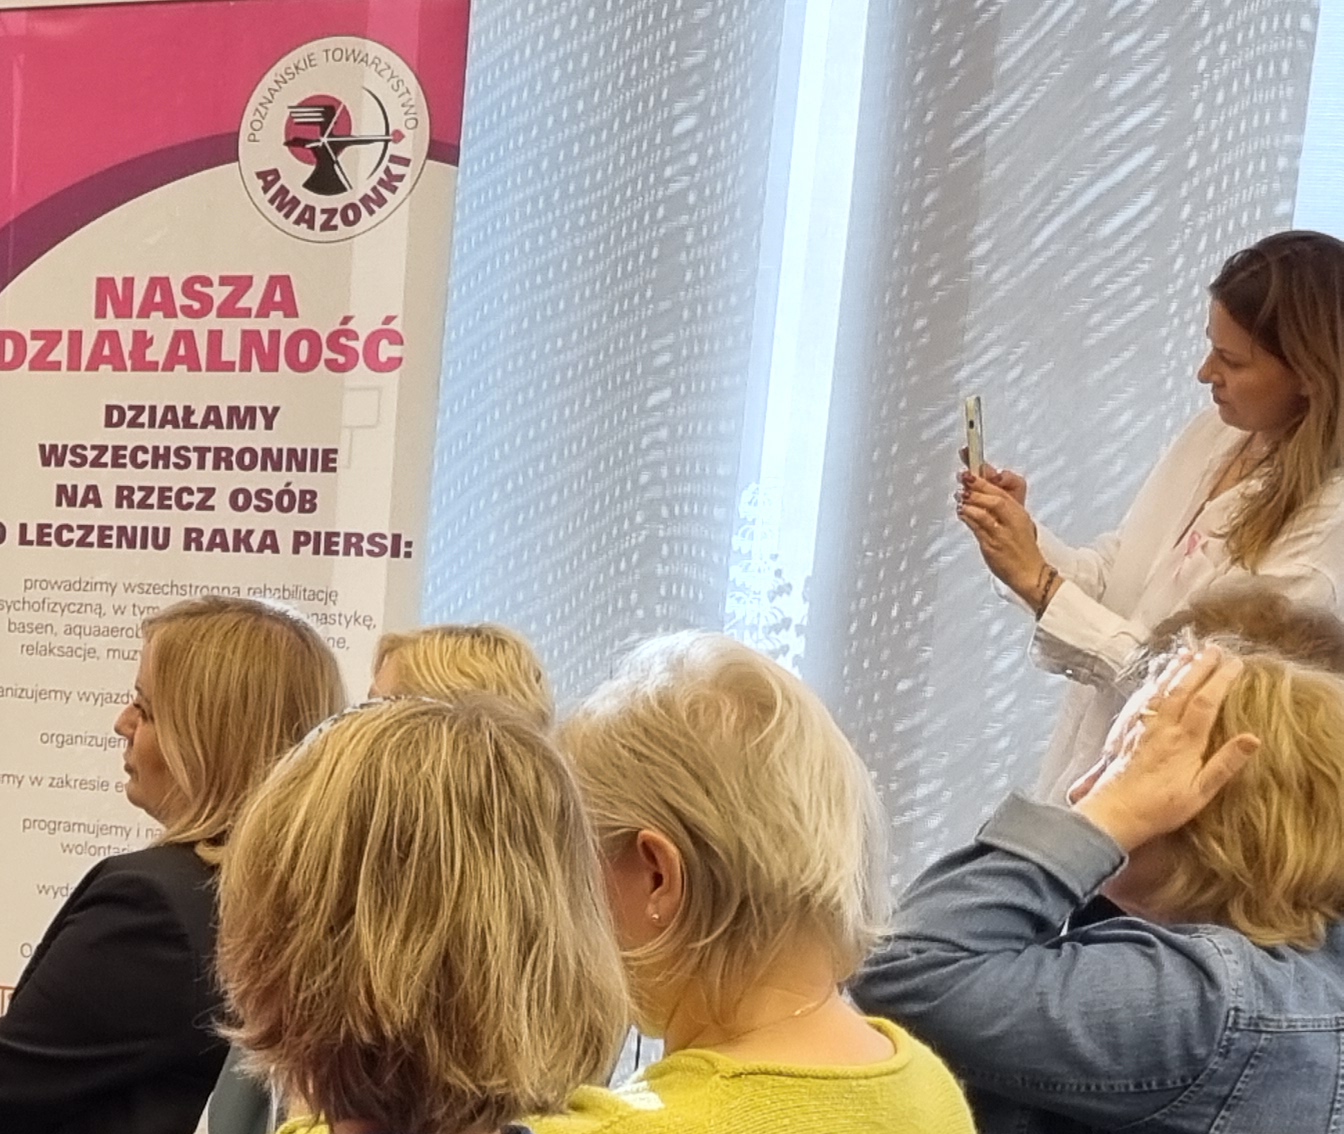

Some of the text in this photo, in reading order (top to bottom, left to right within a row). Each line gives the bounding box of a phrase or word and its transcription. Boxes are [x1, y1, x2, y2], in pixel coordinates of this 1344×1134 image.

[247, 47, 419, 143] POZNAŃSKIE TOWARZYSTWO
[255, 154, 412, 232] AMAZONKI
[93, 274, 299, 319] NASZA
[103, 404, 280, 431] DZIAŁAMY
[38, 443, 338, 473] WSZECHSTRONNIE
[55, 481, 318, 514] NA RZECZ OSÓB
[18, 521, 171, 552] LECZENIU
[182, 526, 280, 555] RAKA
[292, 530, 413, 559] PIERSI:
[23, 575, 118, 598] prowadzimy
[112, 604, 127, 616] w
[7, 618, 143, 640] basen, aquaaerob
[20, 640, 100, 662] relaksacje,
[29, 775, 44, 787] w
[48, 773, 110, 792] zakresie
[22, 817, 132, 840] programujemy
